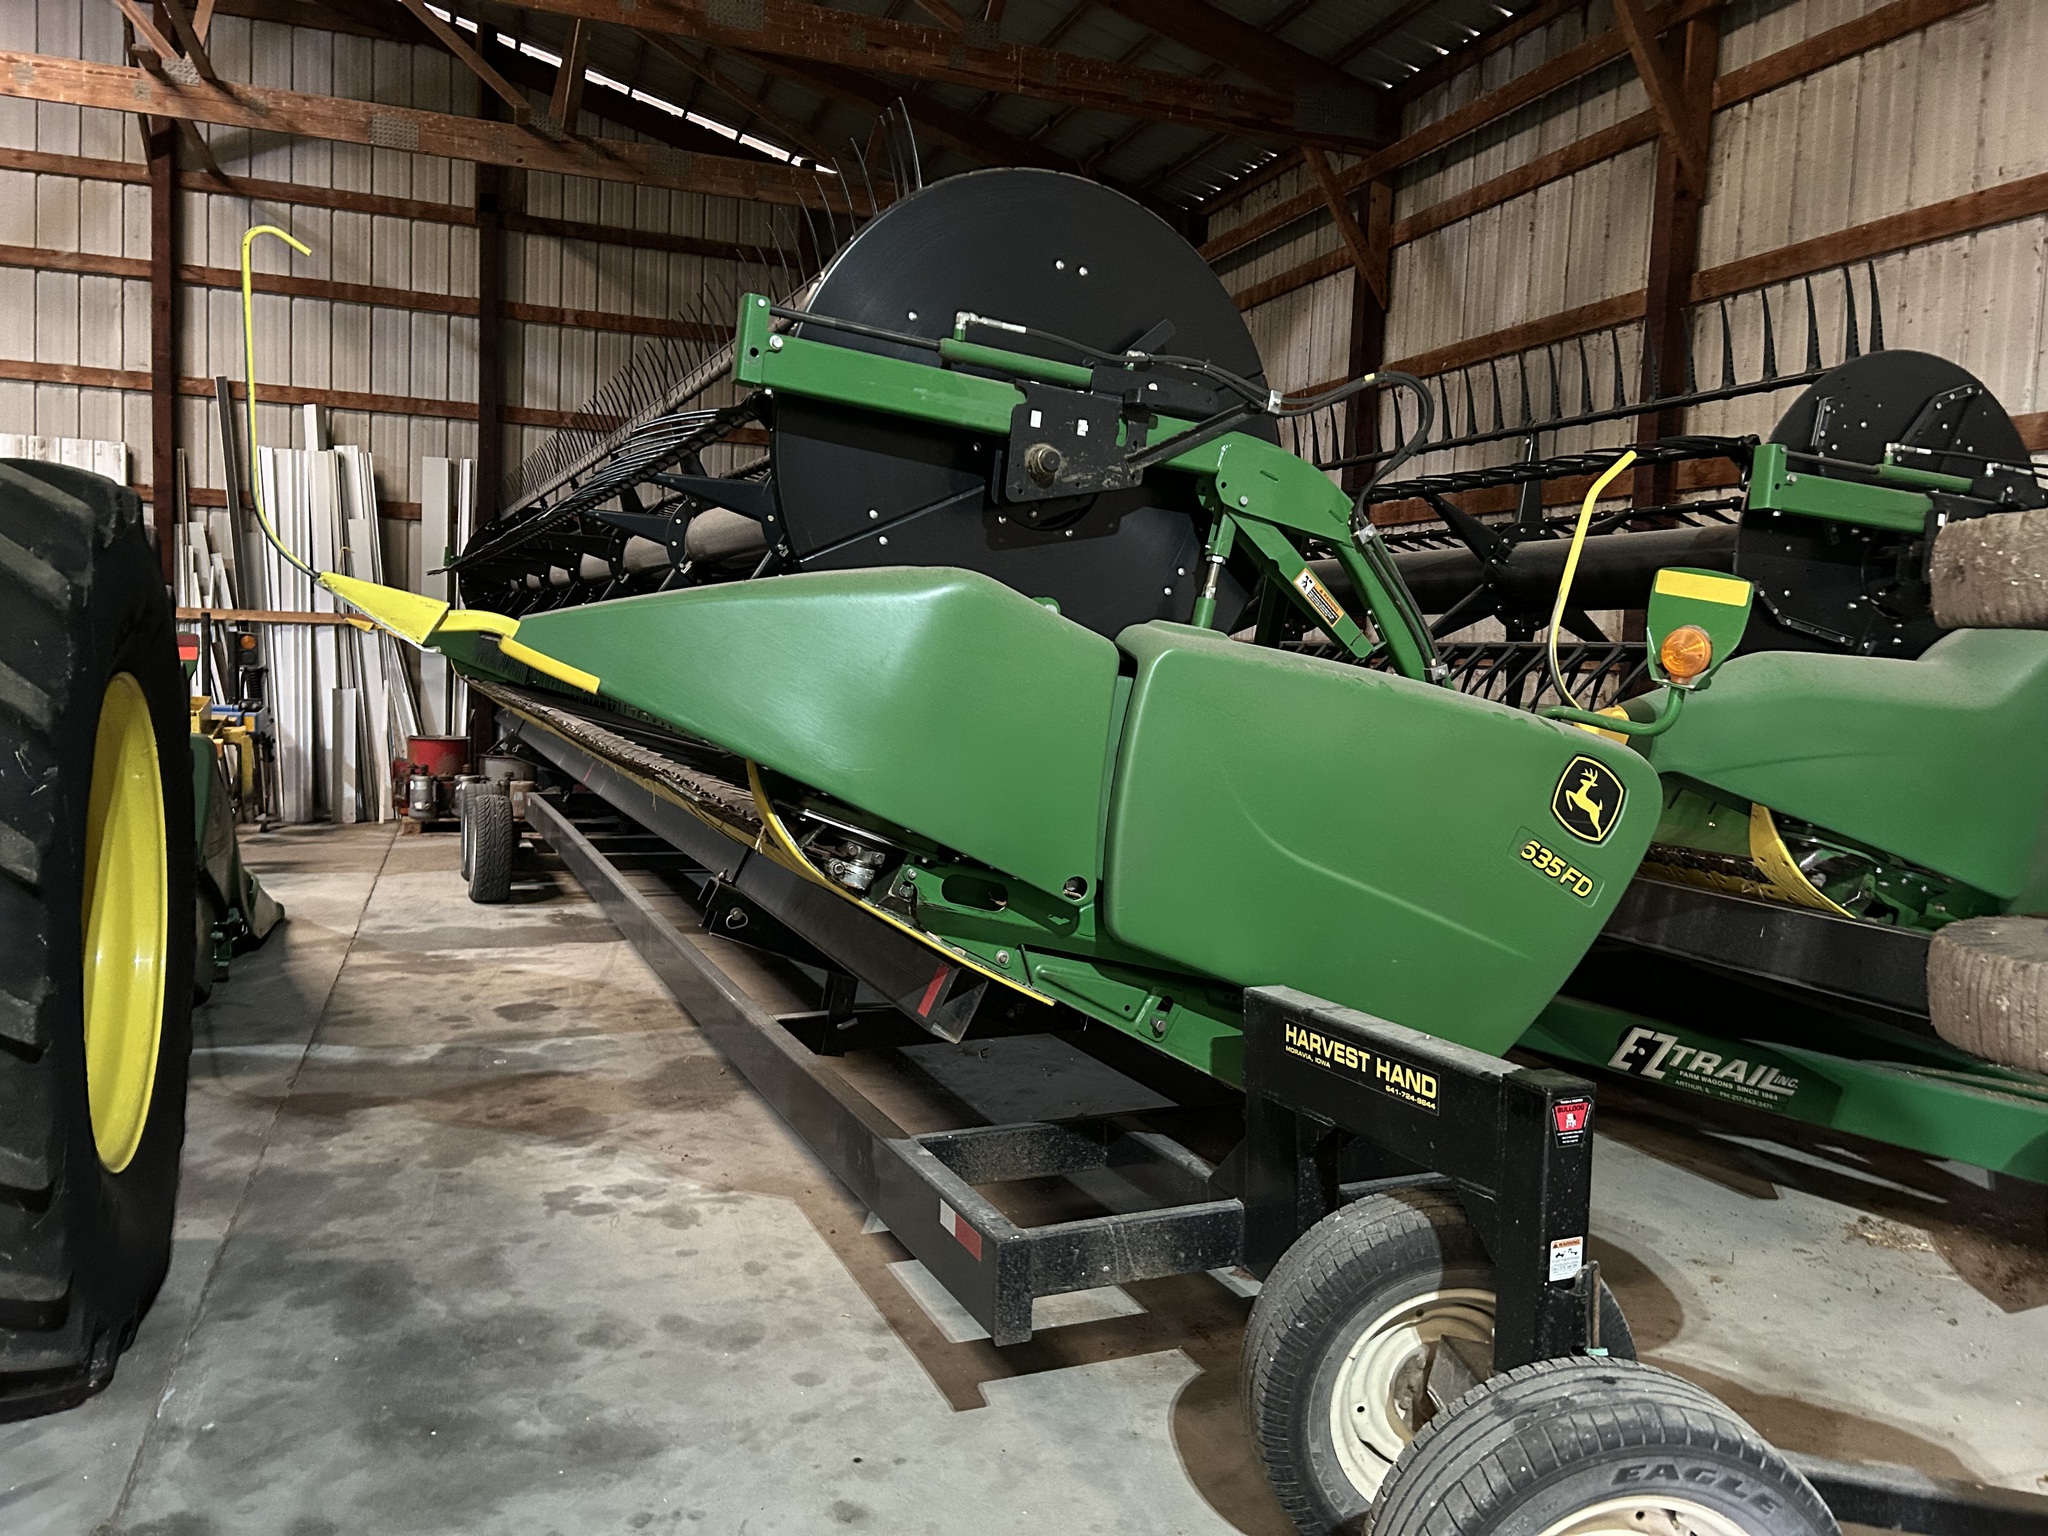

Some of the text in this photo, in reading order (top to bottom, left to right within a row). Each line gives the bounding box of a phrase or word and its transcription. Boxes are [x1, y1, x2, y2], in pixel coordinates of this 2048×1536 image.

[1519, 838, 1595, 899] 635FD
[1285, 1045, 1331, 1069] MORAVIA, IOWA
[1285, 1023, 1437, 1099] HARVEST HAND
[1668, 1044, 1796, 1096] TRAIL
[1773, 1074, 1799, 1089] INC.
[1557, 1104, 1585, 1114] BULLDOG
[1679, 1070, 1700, 1081] FARM
[1701, 1075, 1734, 1090] WAGONS
[1736, 1084, 1760, 1097] SINCE
[1611, 1463, 1783, 1517] EAGLE
